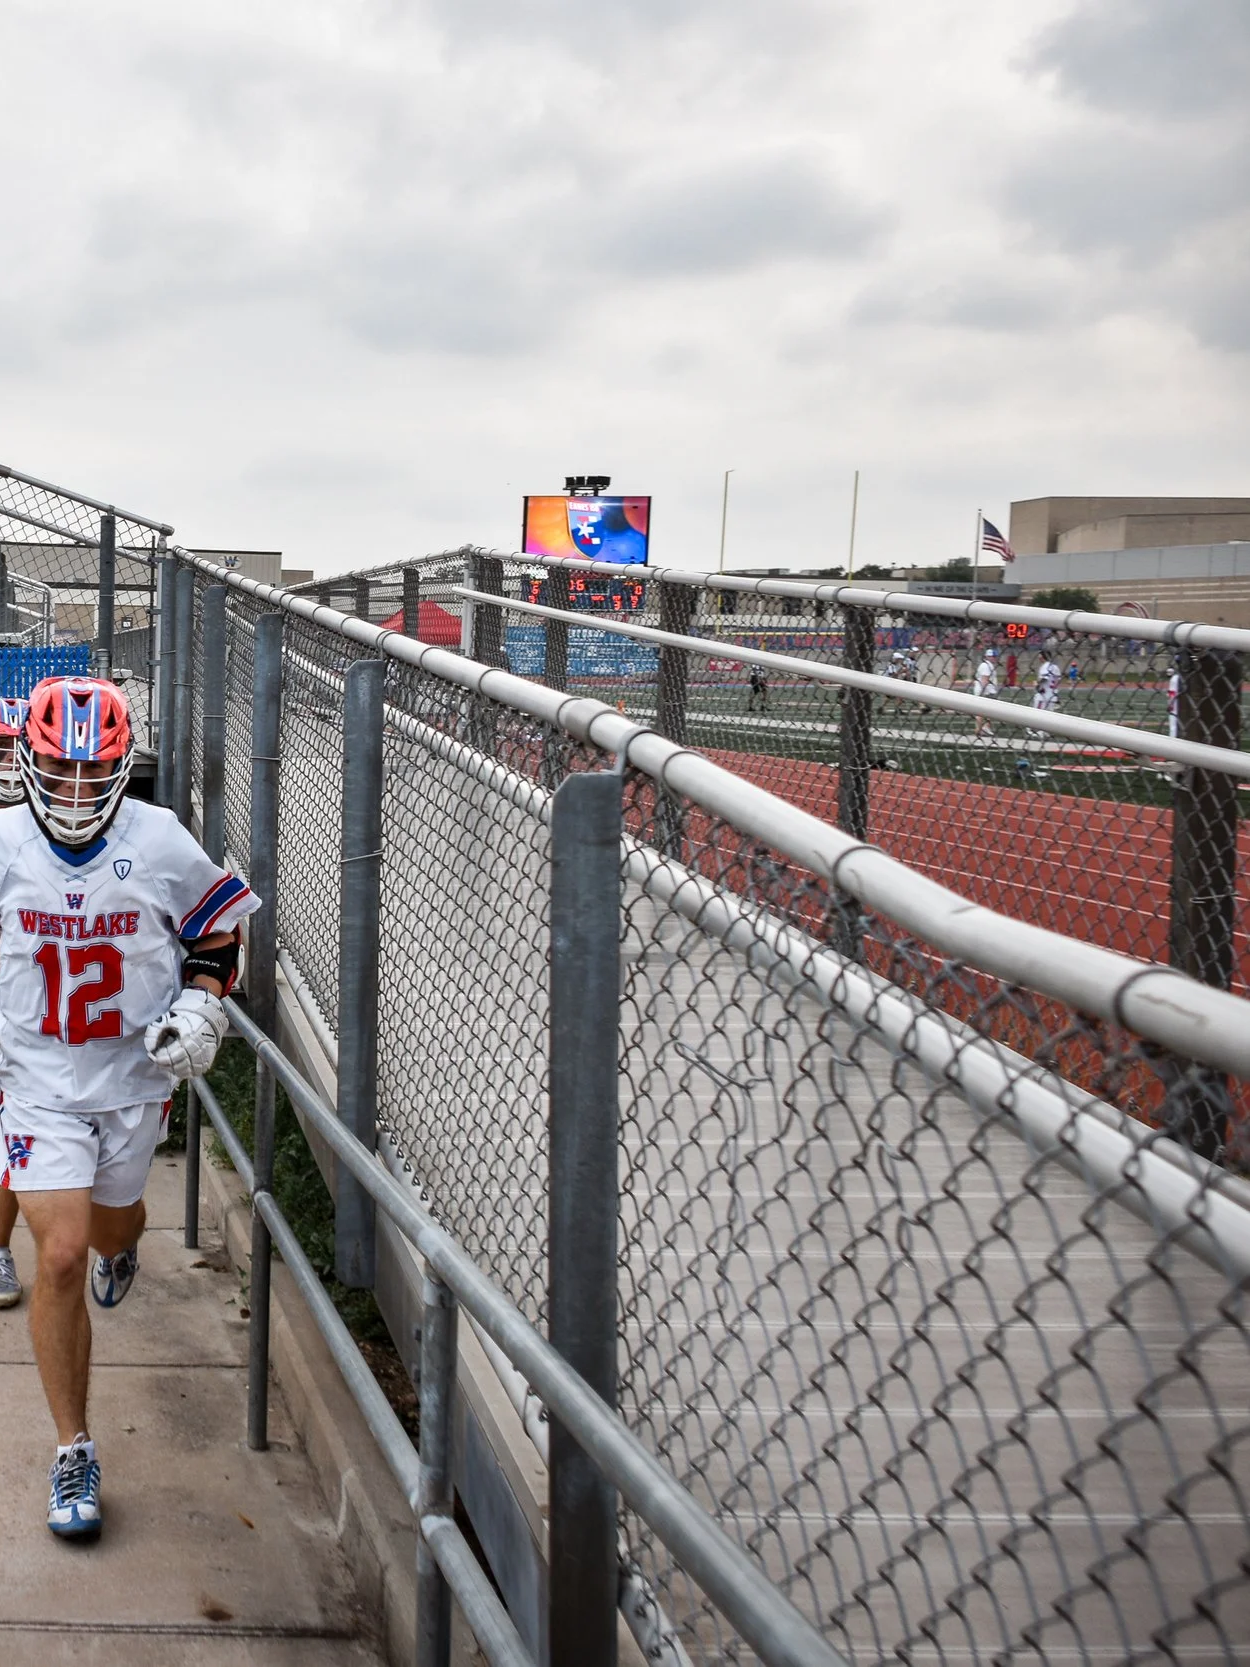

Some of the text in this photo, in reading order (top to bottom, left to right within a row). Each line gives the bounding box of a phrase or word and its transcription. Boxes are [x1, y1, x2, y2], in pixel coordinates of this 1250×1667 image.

[65, 893, 85, 910] W
[17, 908, 140, 941] WESTLAKE
[32, 941, 125, 1047] 12
[4, 1133, 36, 1171] W
